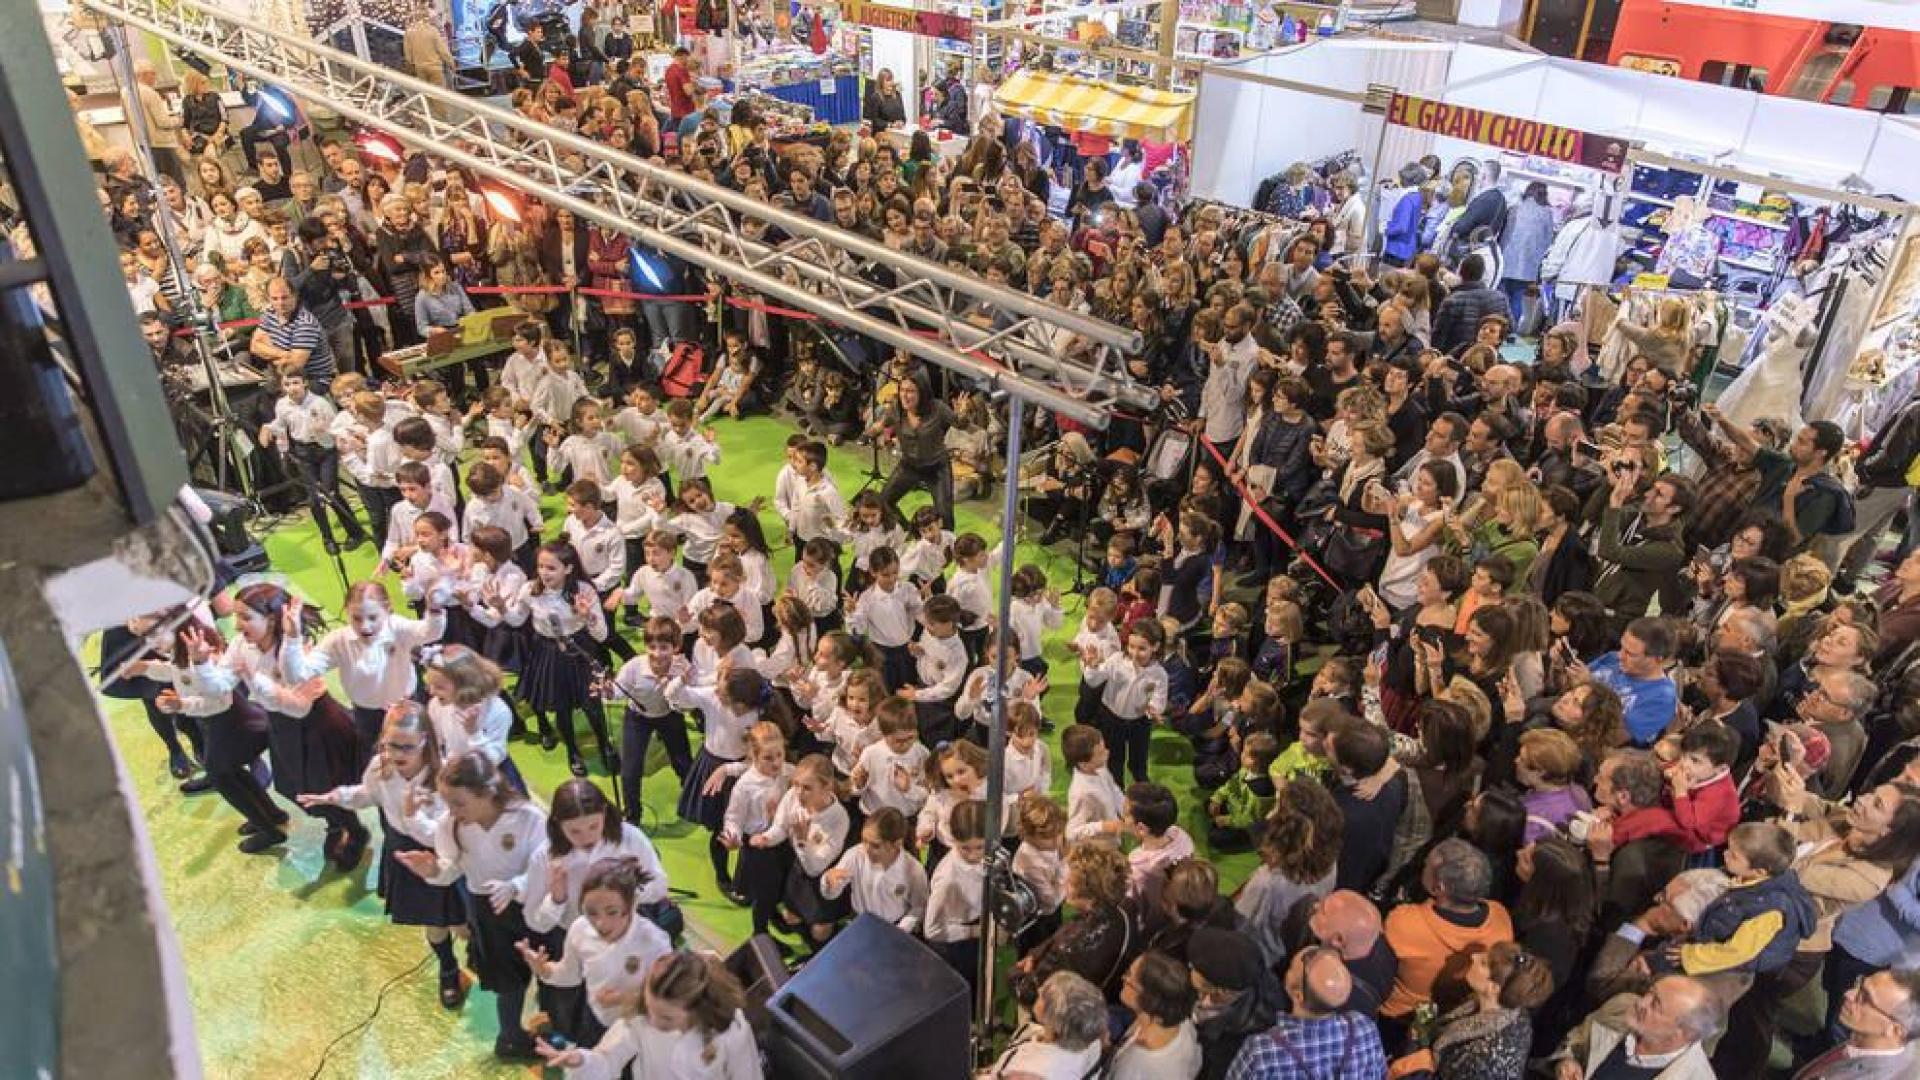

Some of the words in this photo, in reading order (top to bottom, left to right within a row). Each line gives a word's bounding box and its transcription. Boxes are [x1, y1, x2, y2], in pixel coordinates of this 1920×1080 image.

[1389, 95, 1409, 126] EL
[1418, 100, 1483, 143] GRAN
[1488, 114, 1575, 161] CHOLLO
